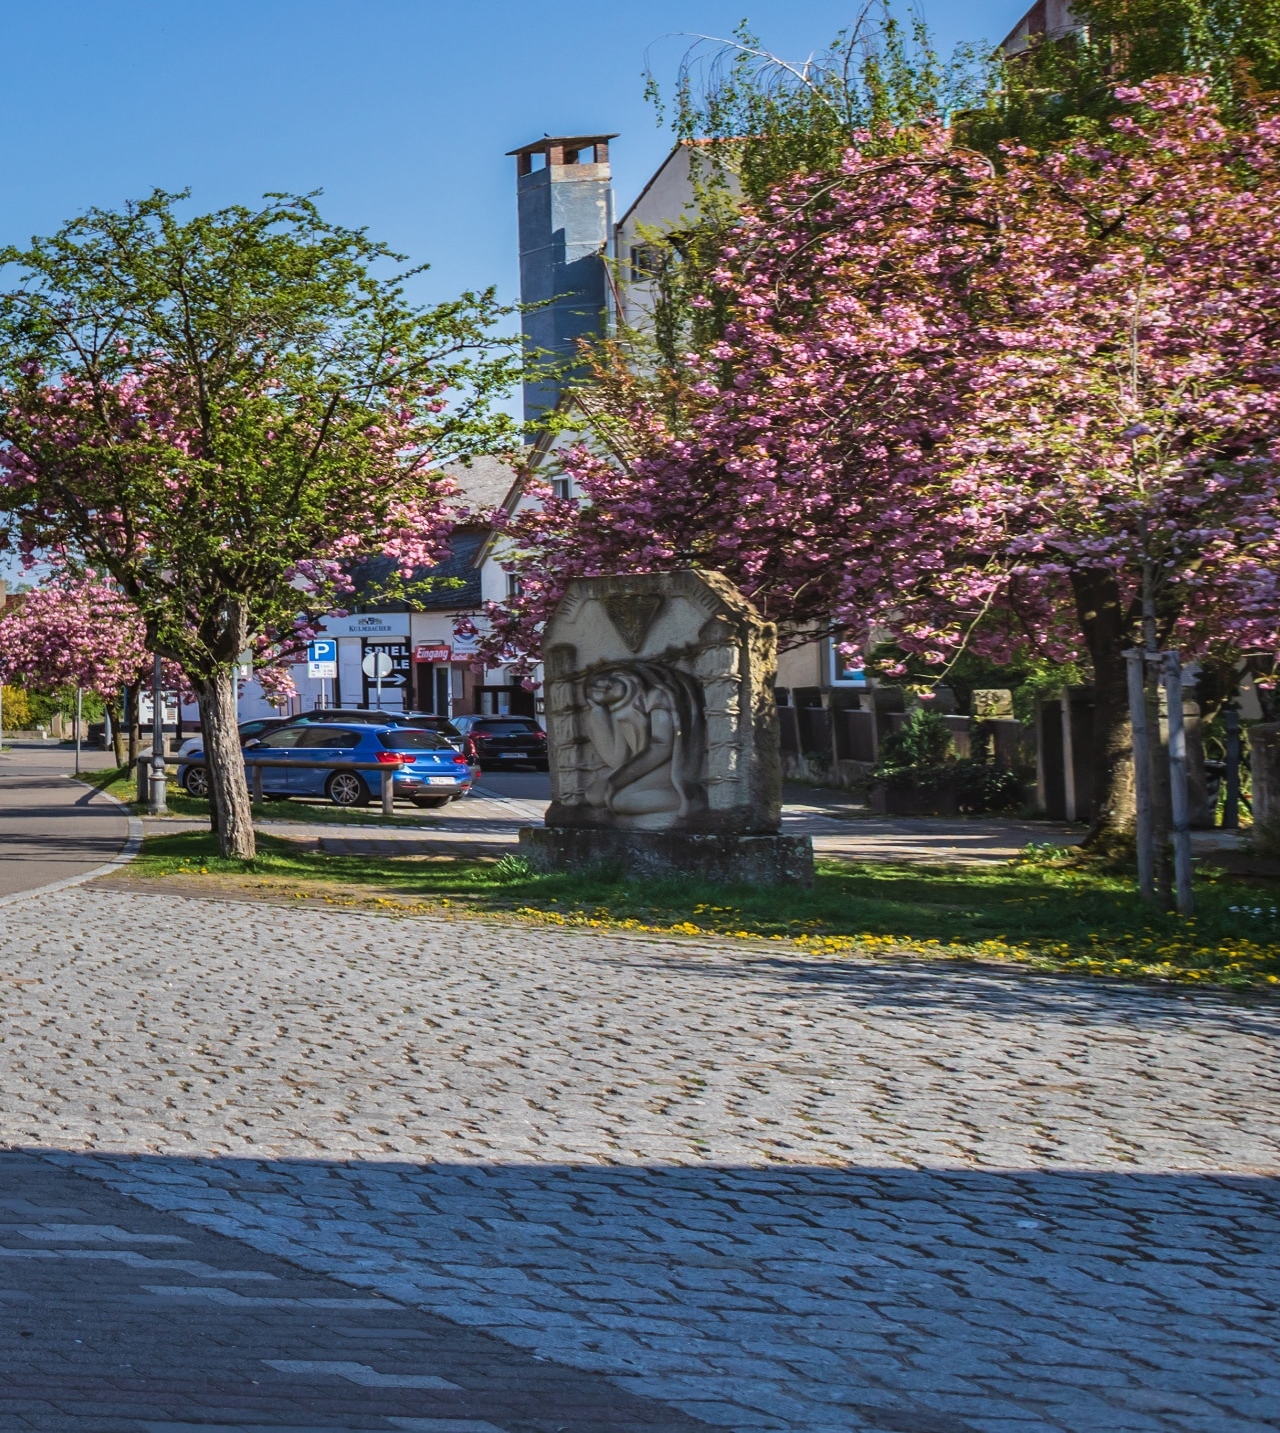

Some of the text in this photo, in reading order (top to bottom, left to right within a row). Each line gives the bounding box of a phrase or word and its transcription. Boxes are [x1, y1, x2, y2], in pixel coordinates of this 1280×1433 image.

[314, 643, 330, 659] P
[364, 646, 409, 656] SPIEL
[416, 647, 449, 661] Eingang
